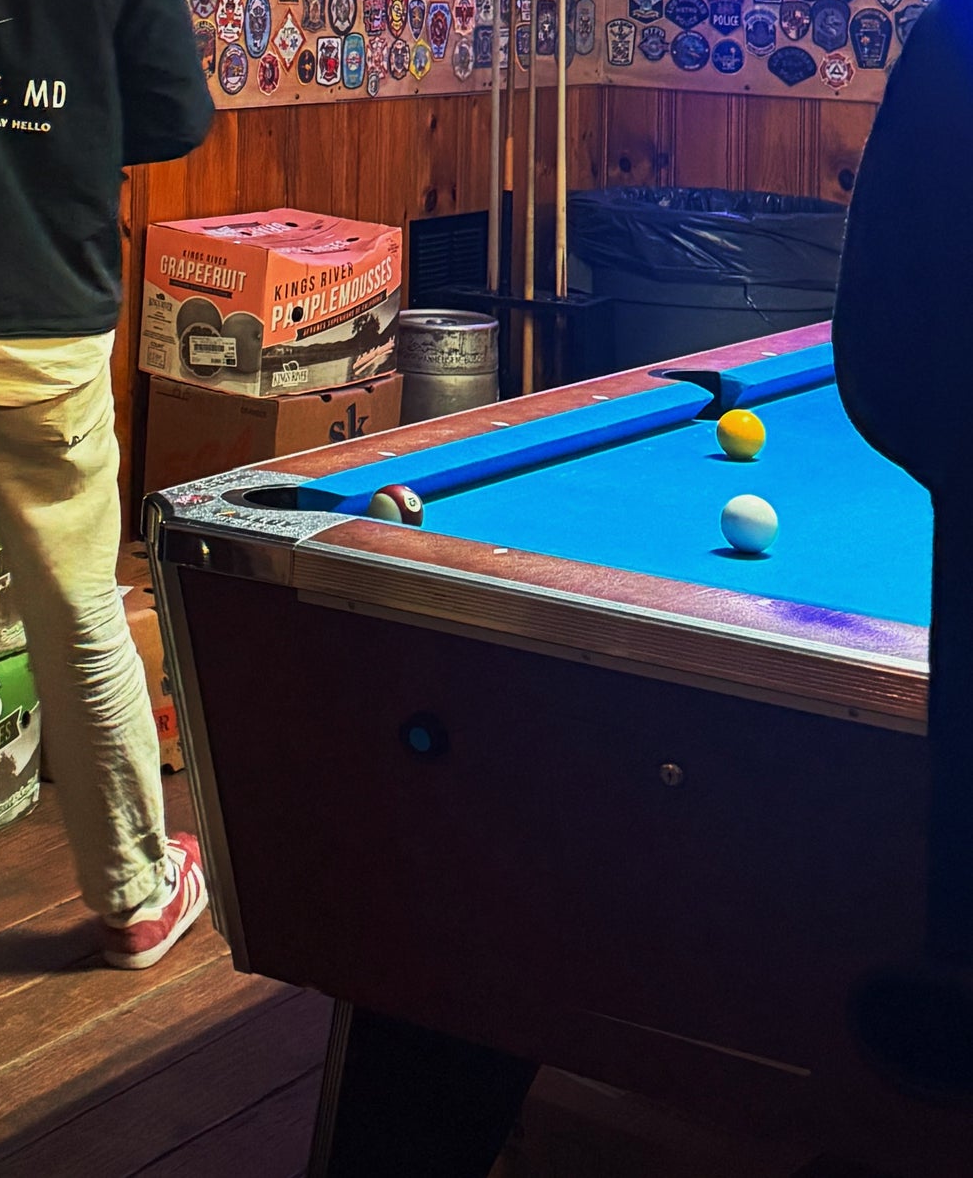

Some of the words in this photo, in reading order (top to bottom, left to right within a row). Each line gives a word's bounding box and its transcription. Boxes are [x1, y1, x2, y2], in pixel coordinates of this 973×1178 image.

[713, 14, 739, 27] POLICE
[24, 79, 67, 109] MD
[11, 119, 52, 132] HELLO
[182, 249, 204, 261] KINGS
[207, 254, 228, 266] RIVER
[160, 254, 247, 292] GRAPEFRUIT
[274, 275, 316, 302] KINGS
[320, 262, 354, 288] RIVER
[271, 255, 393, 333] PAMPLEMOUSSES
